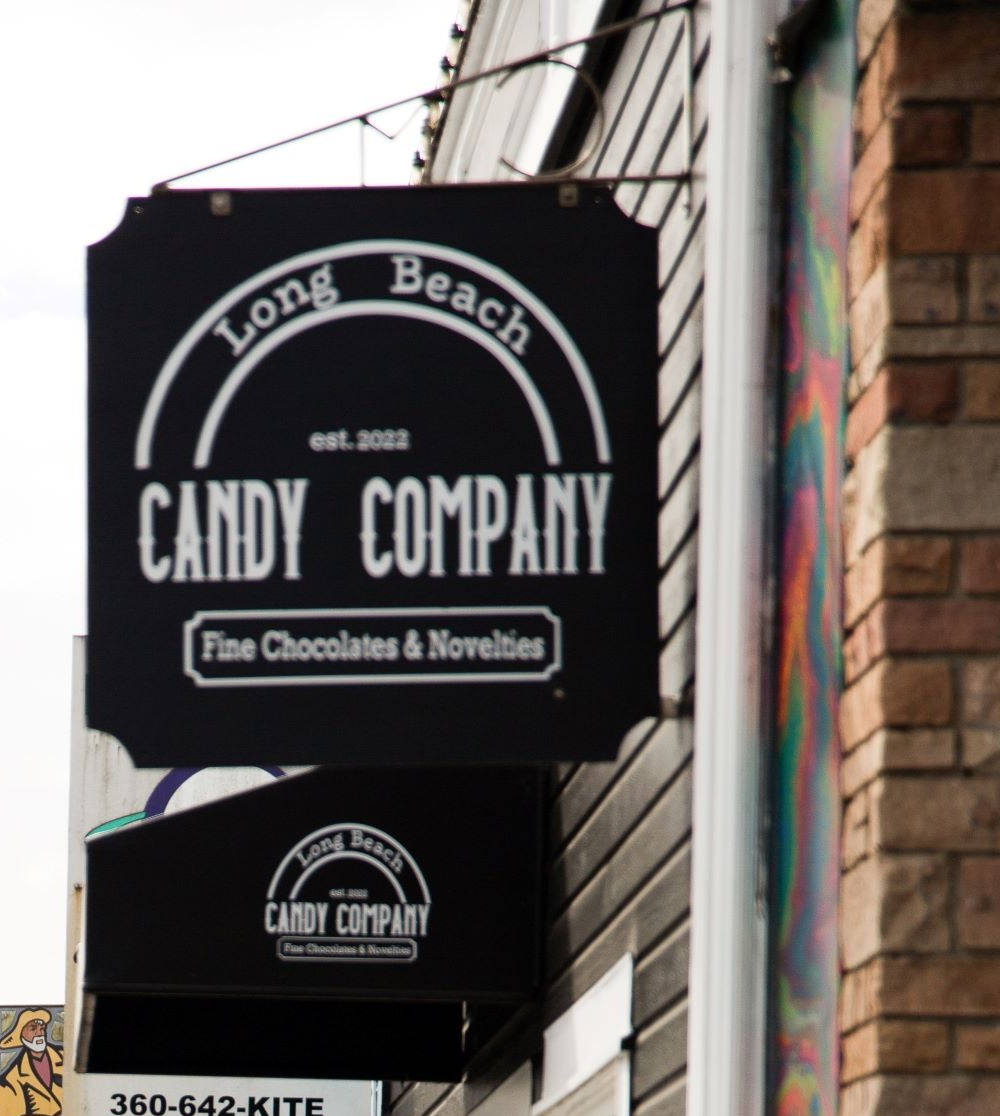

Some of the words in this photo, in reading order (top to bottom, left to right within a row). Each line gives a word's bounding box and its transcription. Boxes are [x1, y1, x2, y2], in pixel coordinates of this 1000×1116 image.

[213, 262, 340, 357] Long
[390, 253, 532, 356] Beach
[356, 428, 410, 452] 2022
[138, 478, 309, 583] CANDY
[360, 473, 613, 578] COMPANY
[202, 630, 257, 662] Fine
[261, 629, 398, 661] Chocolates
[403, 628, 423, 658] &
[428, 628, 545, 659] Novelties
[296, 832, 345, 868] Long
[351, 829, 404, 875] Beach
[264, 901, 328, 935] CANDY
[335, 902, 431, 937] COMPANY
